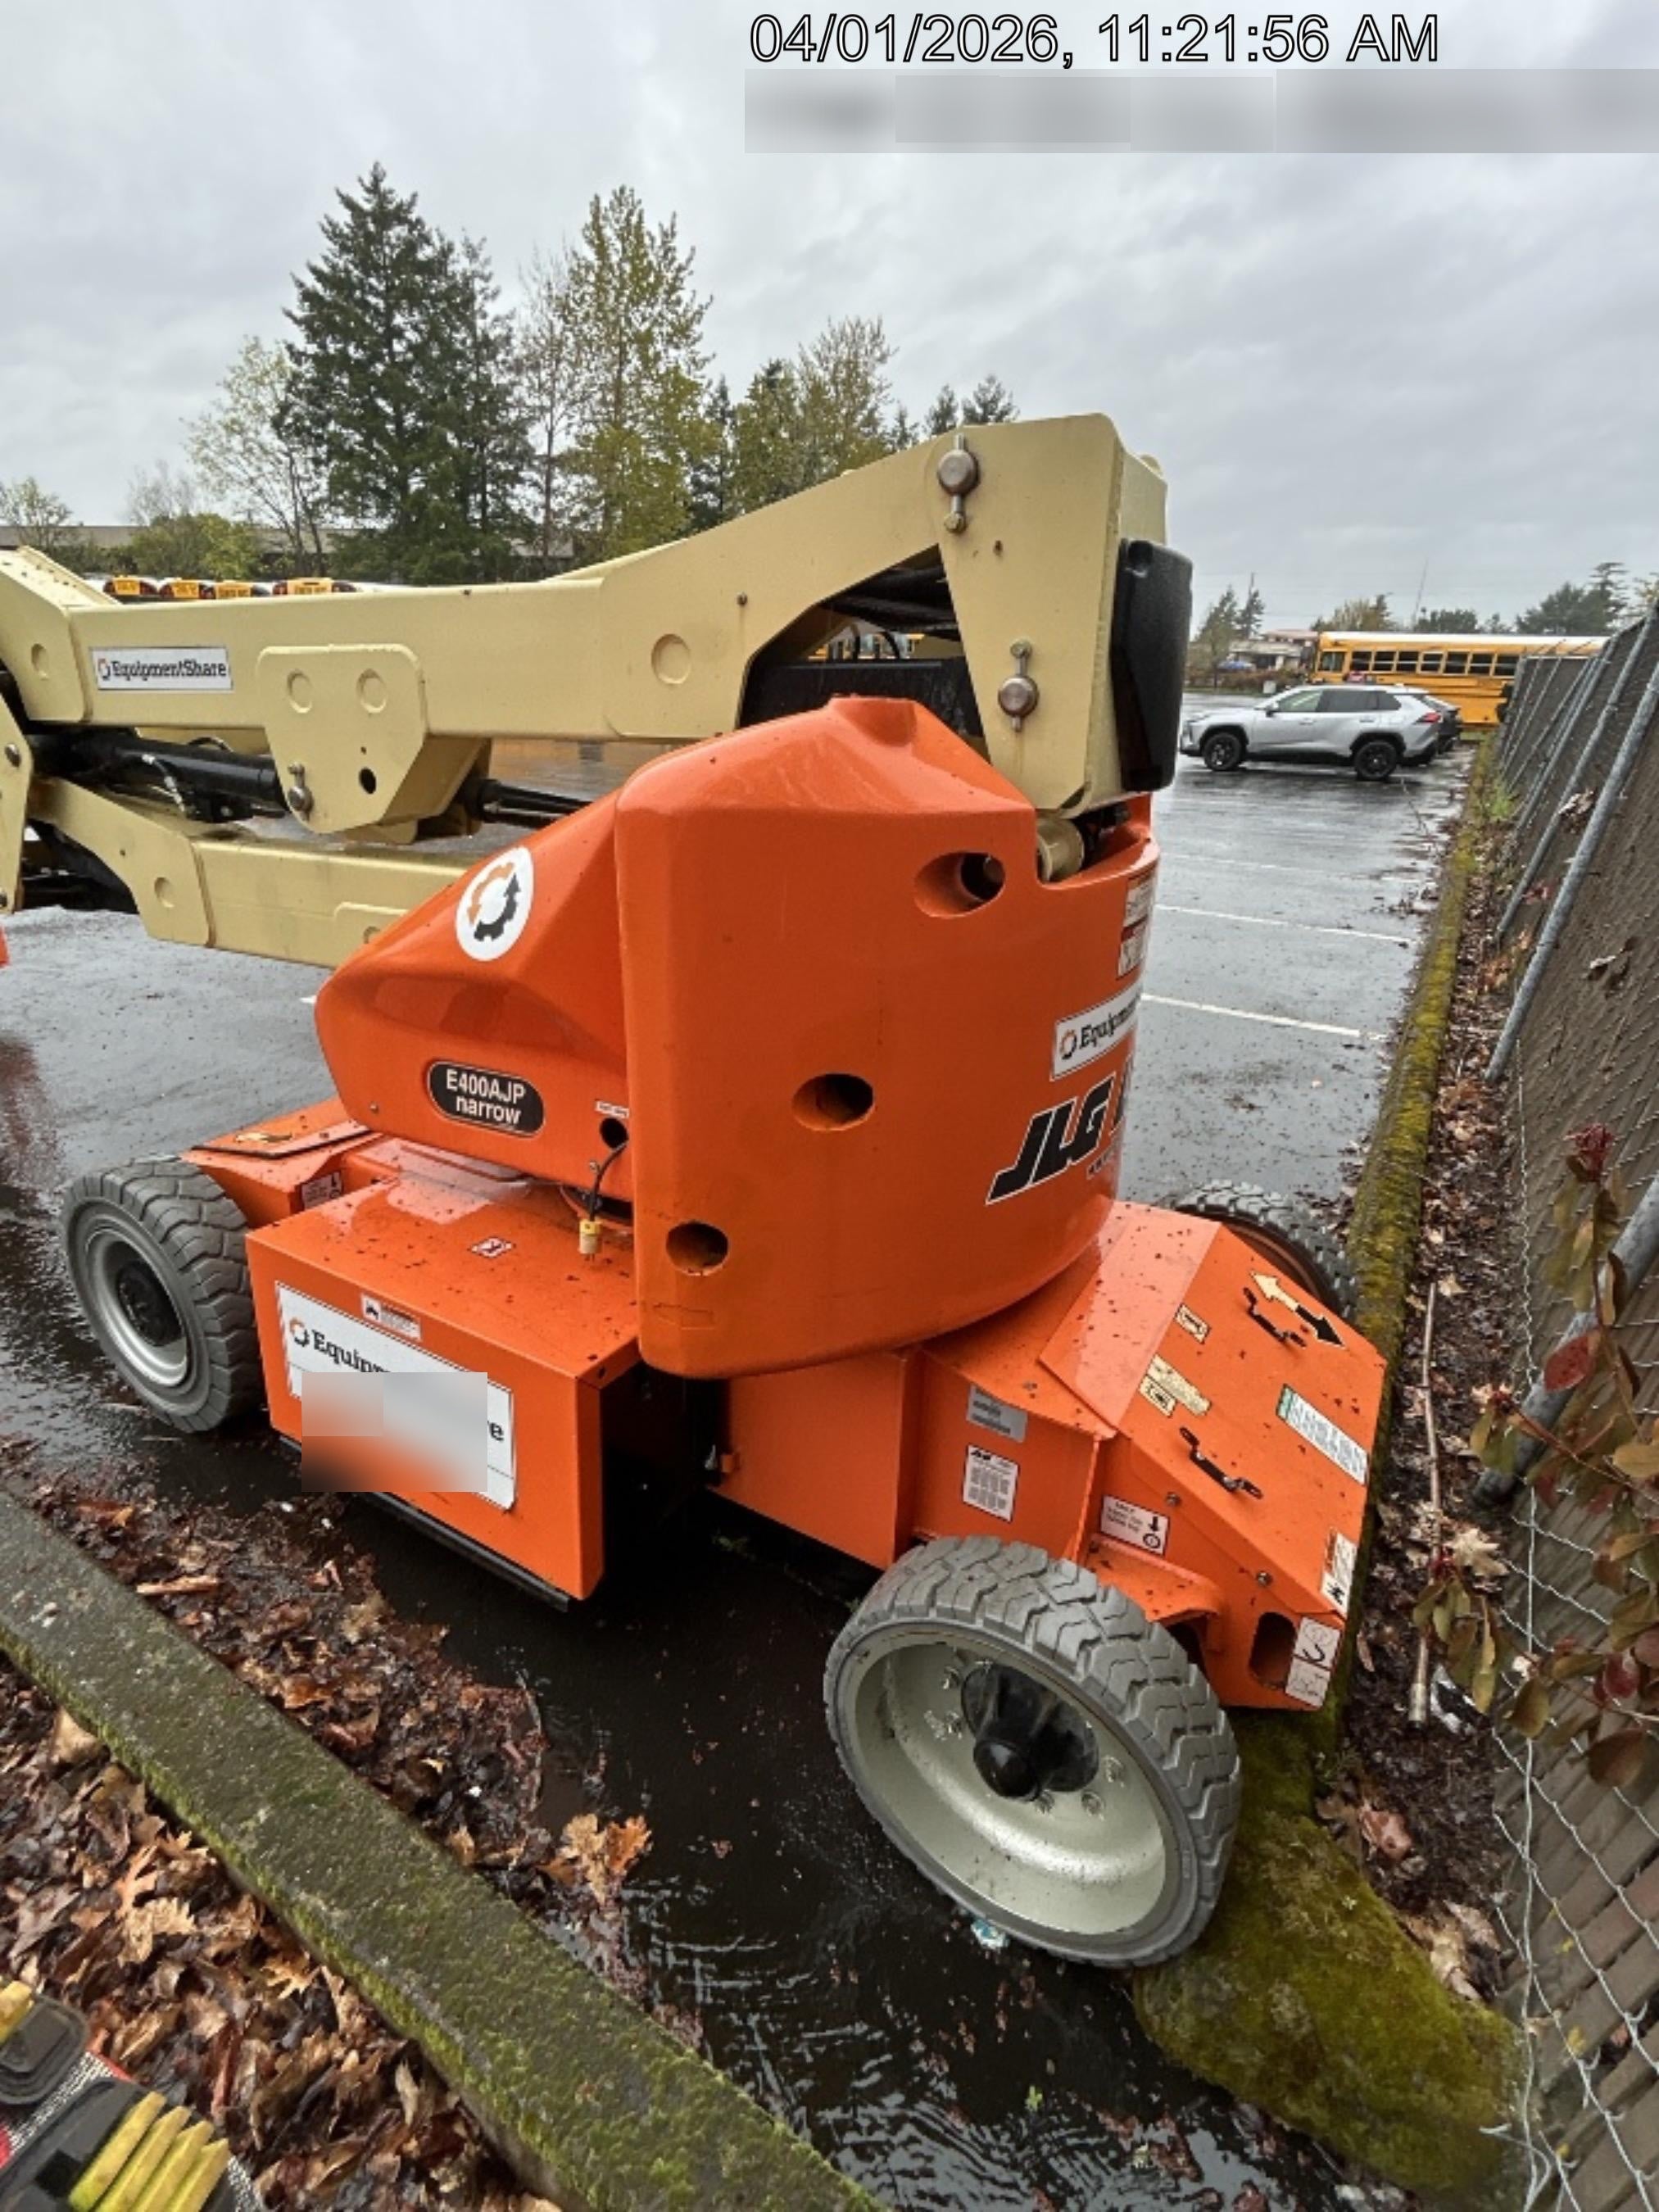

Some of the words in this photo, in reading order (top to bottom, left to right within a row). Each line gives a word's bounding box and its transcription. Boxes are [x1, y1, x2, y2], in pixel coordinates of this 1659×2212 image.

[111, 658, 227, 681] EquipmentShare
[446, 1068, 526, 1104] E400AJP
[456, 1095, 522, 1126] narrow
[985, 1071, 1117, 1206] JLG
